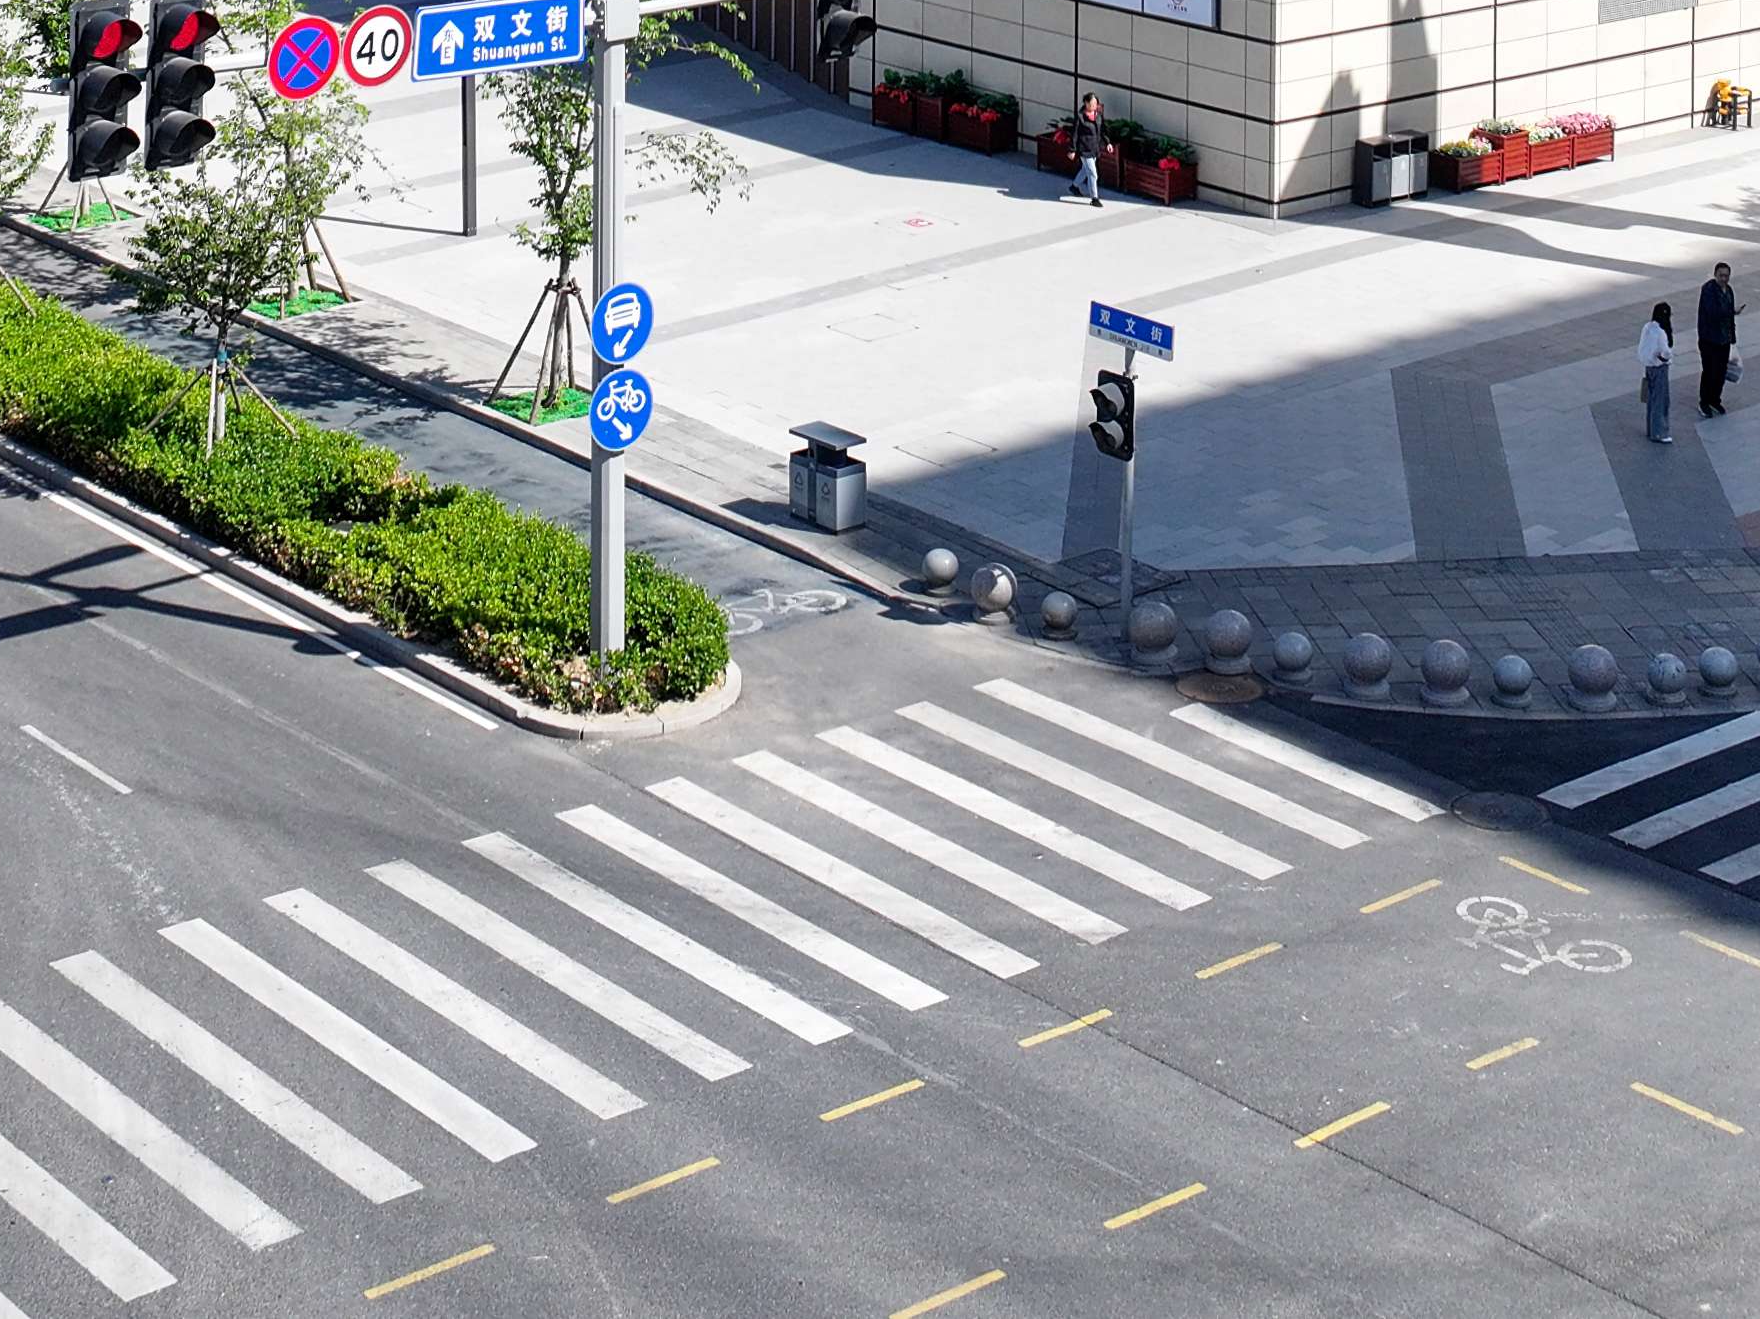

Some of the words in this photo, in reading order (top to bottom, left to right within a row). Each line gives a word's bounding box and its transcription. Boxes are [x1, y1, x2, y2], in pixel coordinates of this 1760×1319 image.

[472, 5, 569, 43] 双文街
[355, 28, 400, 65] 40
[472, 40, 545, 64] Shuangwen
[550, 38, 568, 53] St.
[1099, 309, 1163, 343] 双文街
